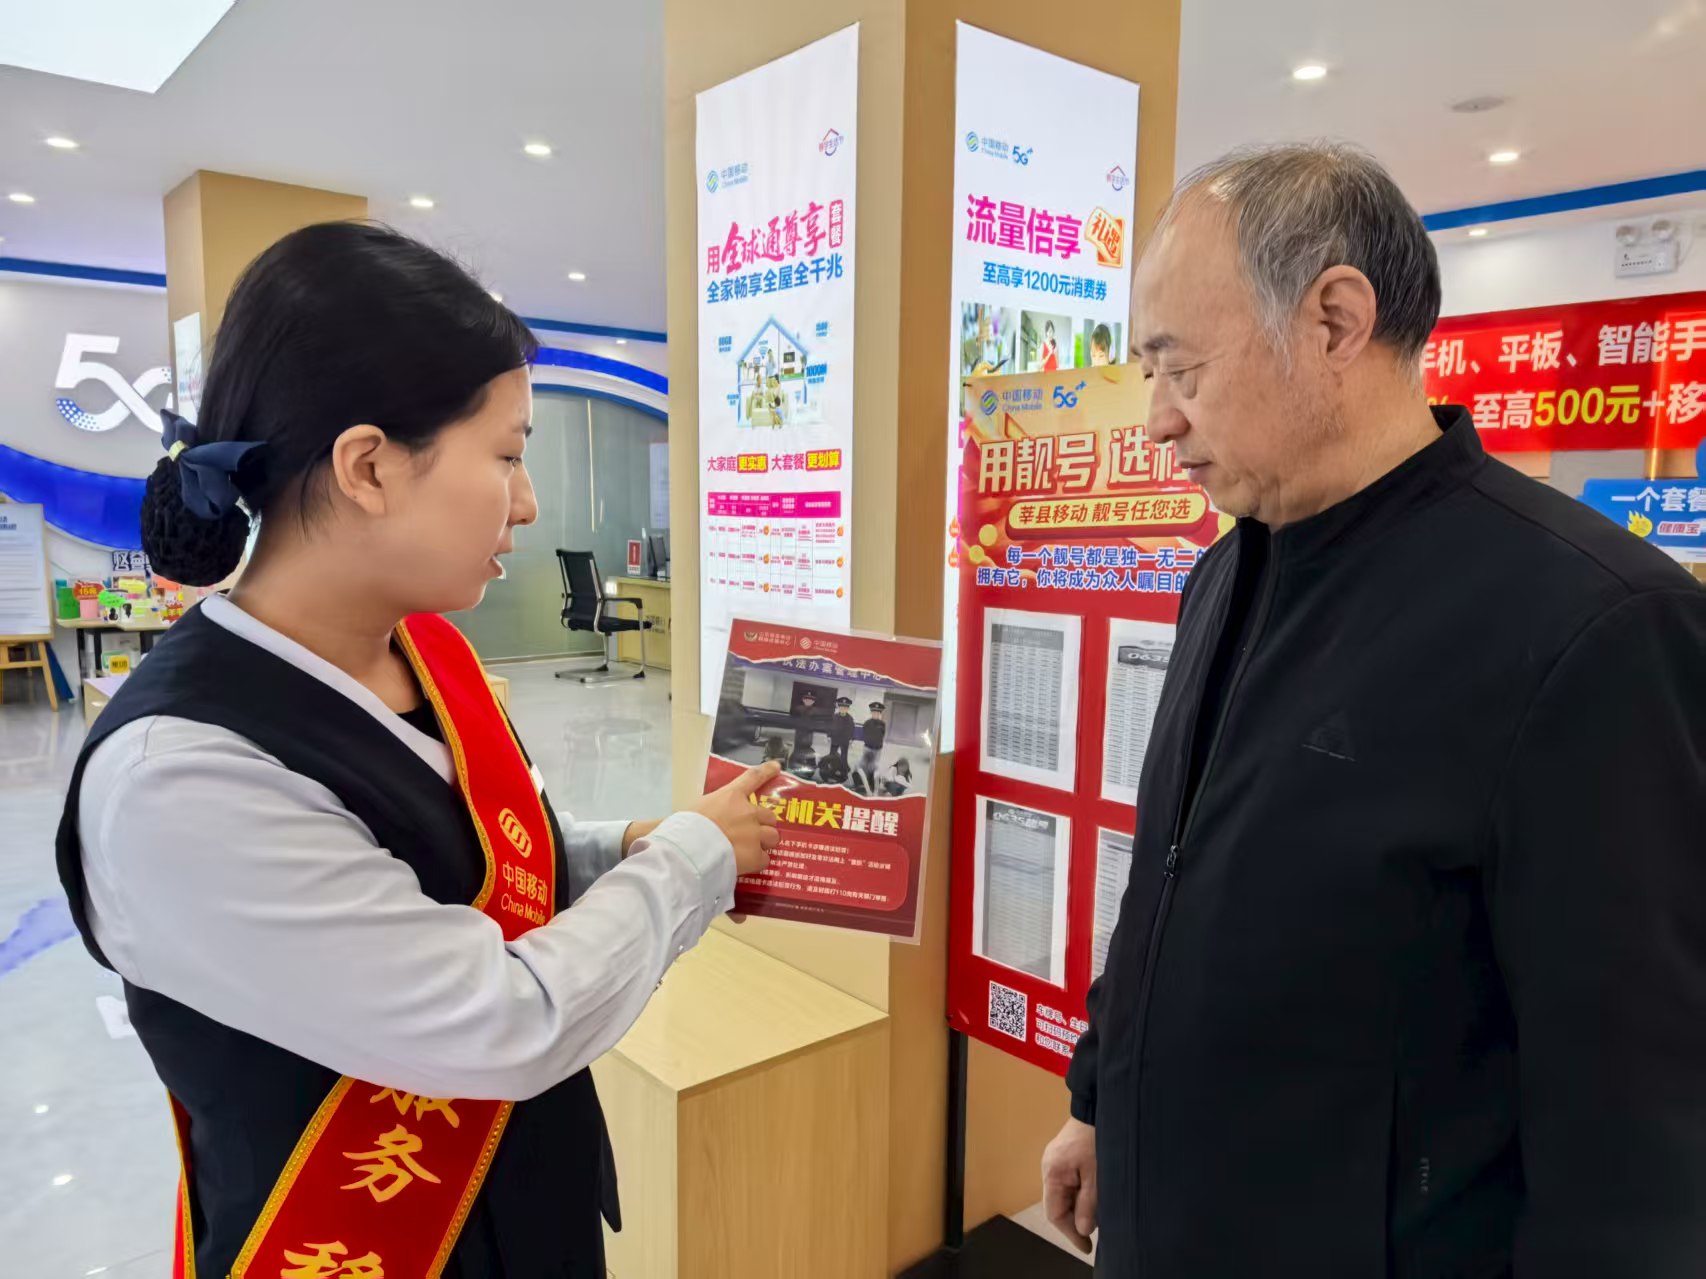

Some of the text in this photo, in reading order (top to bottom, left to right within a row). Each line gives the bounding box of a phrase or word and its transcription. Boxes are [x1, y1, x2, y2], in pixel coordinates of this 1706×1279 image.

[966, 193, 1083, 260] 流量倍享
[707, 253, 843, 304] 全家畅享全屋全千兆
[982, 261, 1107, 301] 至高享1200元消费券
[1002, 388, 1043, 402] 中国移动
[978, 433, 1097, 494] 用靓号
[1019, 499, 1191, 525] 莘县移动 靓号任您选
[1611, 486, 1706, 512] 一个套餐
[748, 792, 899, 837] 安机关提醒
[503, 860, 548, 906] 中国移动
[501, 893, 545, 925] China Mobile
